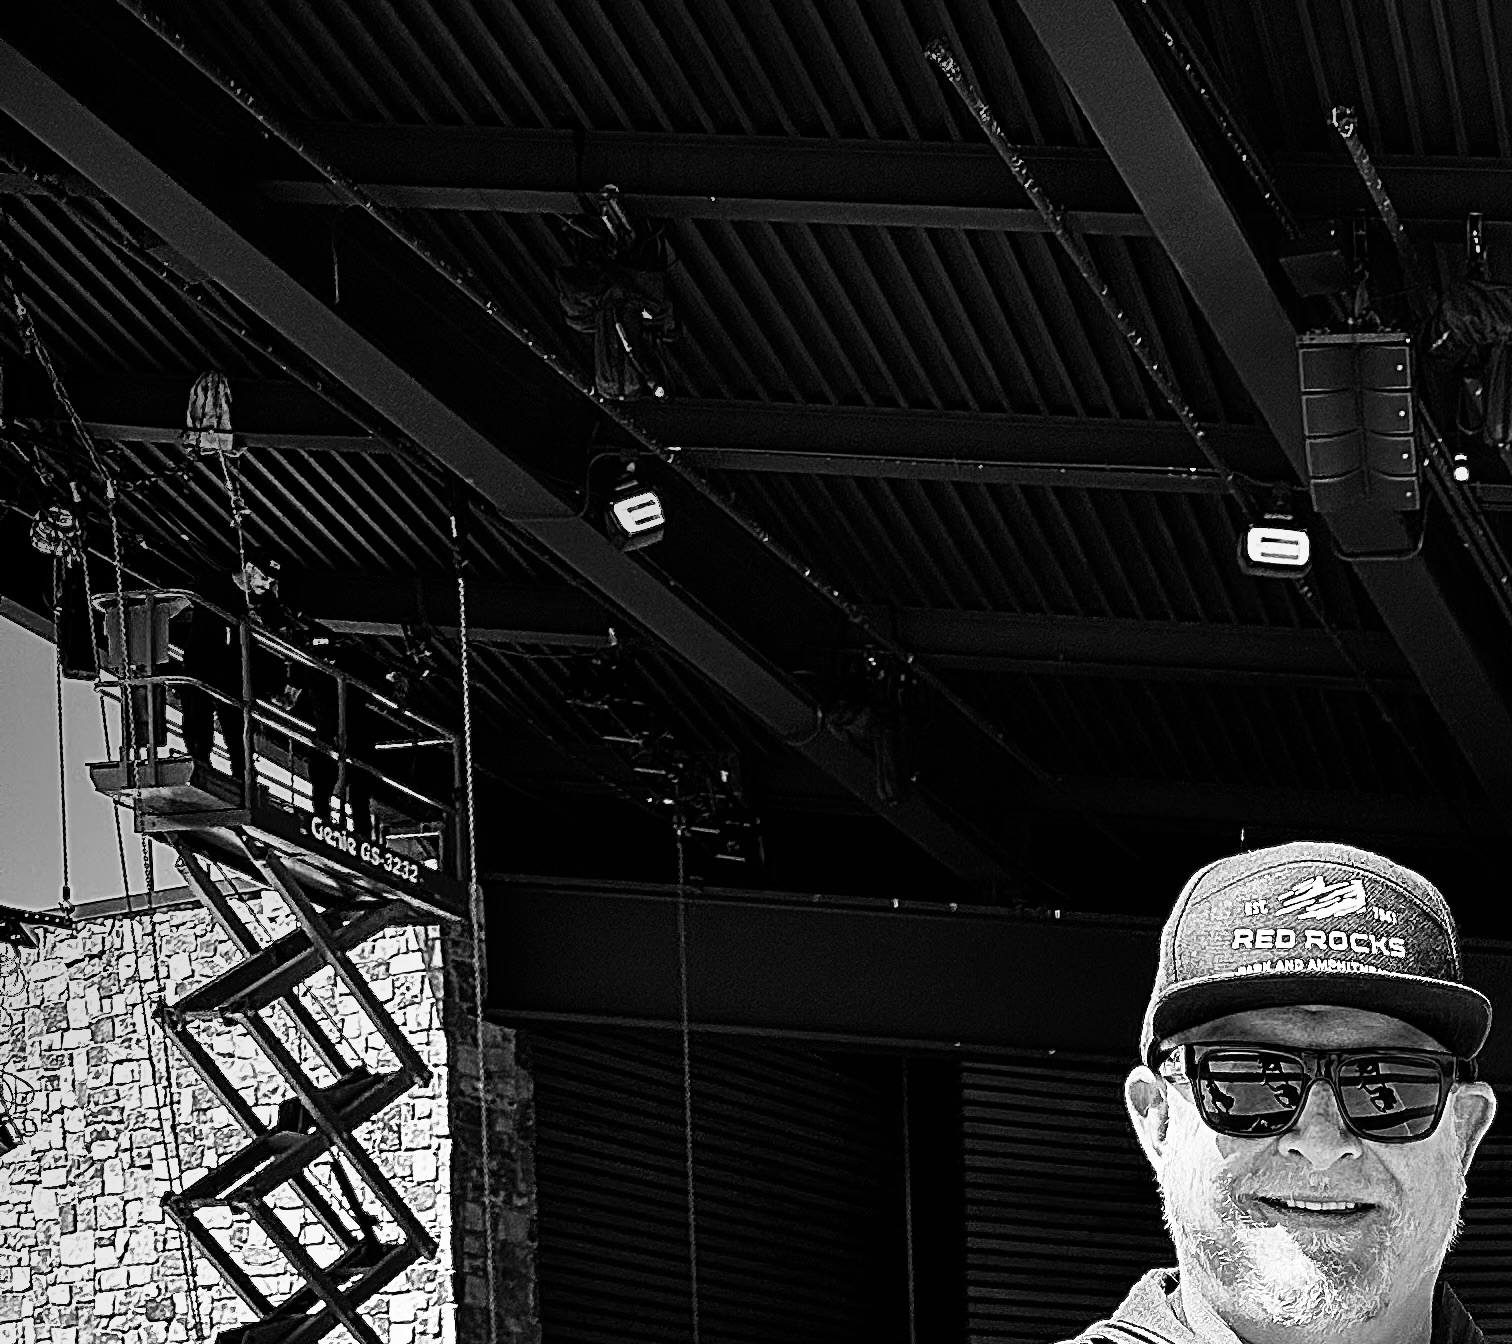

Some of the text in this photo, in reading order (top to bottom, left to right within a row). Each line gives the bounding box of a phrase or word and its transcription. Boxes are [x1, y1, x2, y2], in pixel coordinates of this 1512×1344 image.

[311, 816, 419, 884] Genie GS-3232
[1232, 928, 1406, 958] RED ROCKS
[1275, 959, 1305, 972] AND
